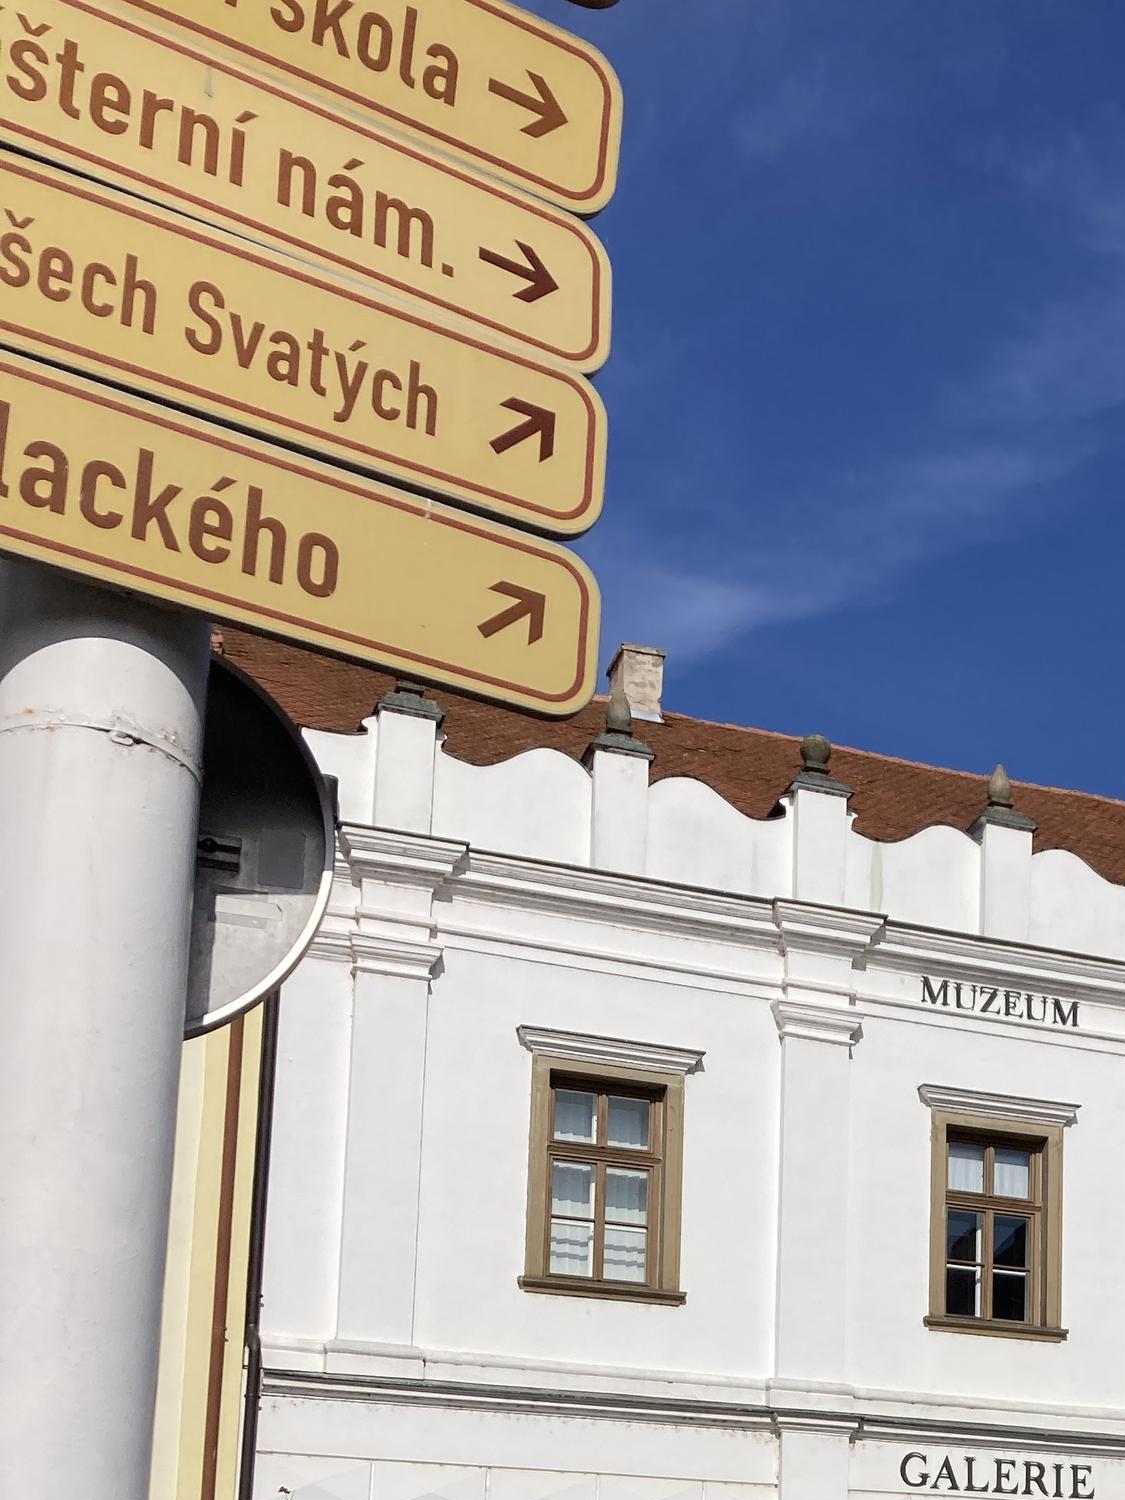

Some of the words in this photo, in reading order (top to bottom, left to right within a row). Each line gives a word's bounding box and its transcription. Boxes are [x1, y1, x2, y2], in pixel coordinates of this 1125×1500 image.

[0, 5, 259, 187] šterní
[277, 148, 457, 278] nám.
[0, 208, 157, 335] šech
[185, 281, 439, 437] Svatých
[920, 975, 1081, 1028] MUZEUM
[899, 1451, 1096, 1500] GALERIE
